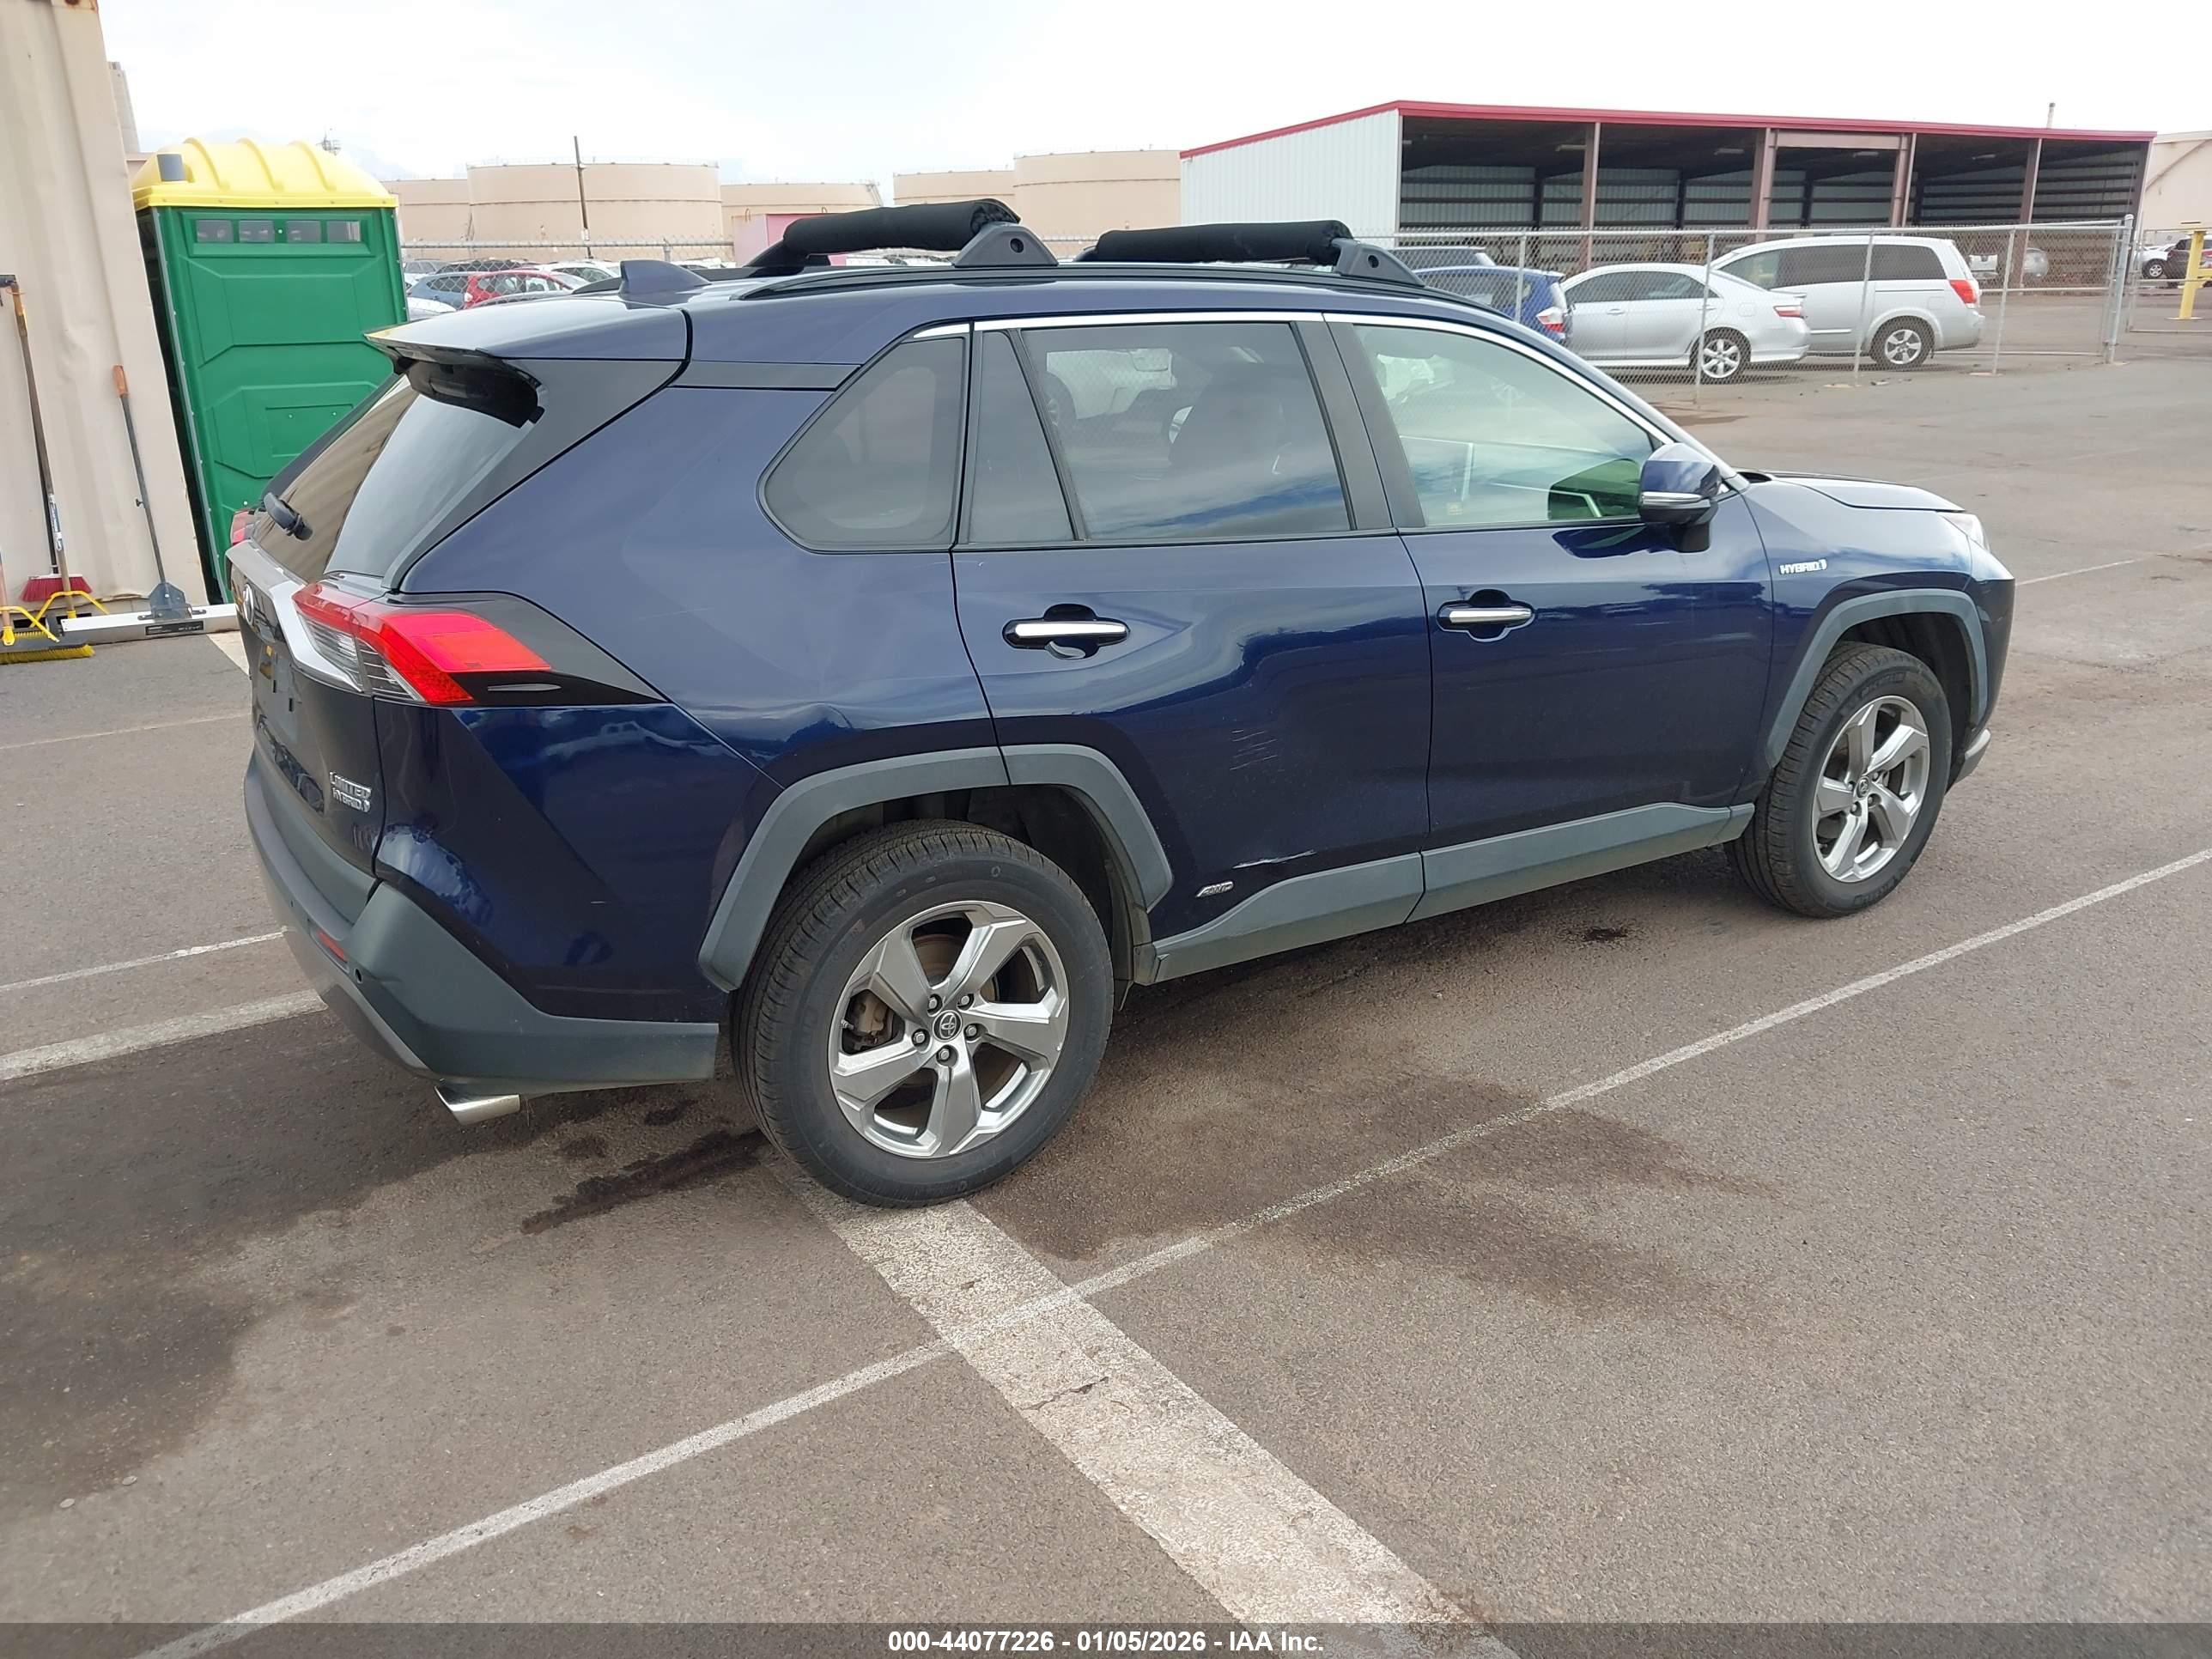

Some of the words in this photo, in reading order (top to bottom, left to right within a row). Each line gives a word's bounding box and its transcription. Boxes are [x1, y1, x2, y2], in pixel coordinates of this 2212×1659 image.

[1779, 561, 1820, 574] HYBRID
[330, 771, 372, 799] LIMITED
[332, 787, 362, 811] HYBRID
[1196, 881, 1234, 897] AWD
